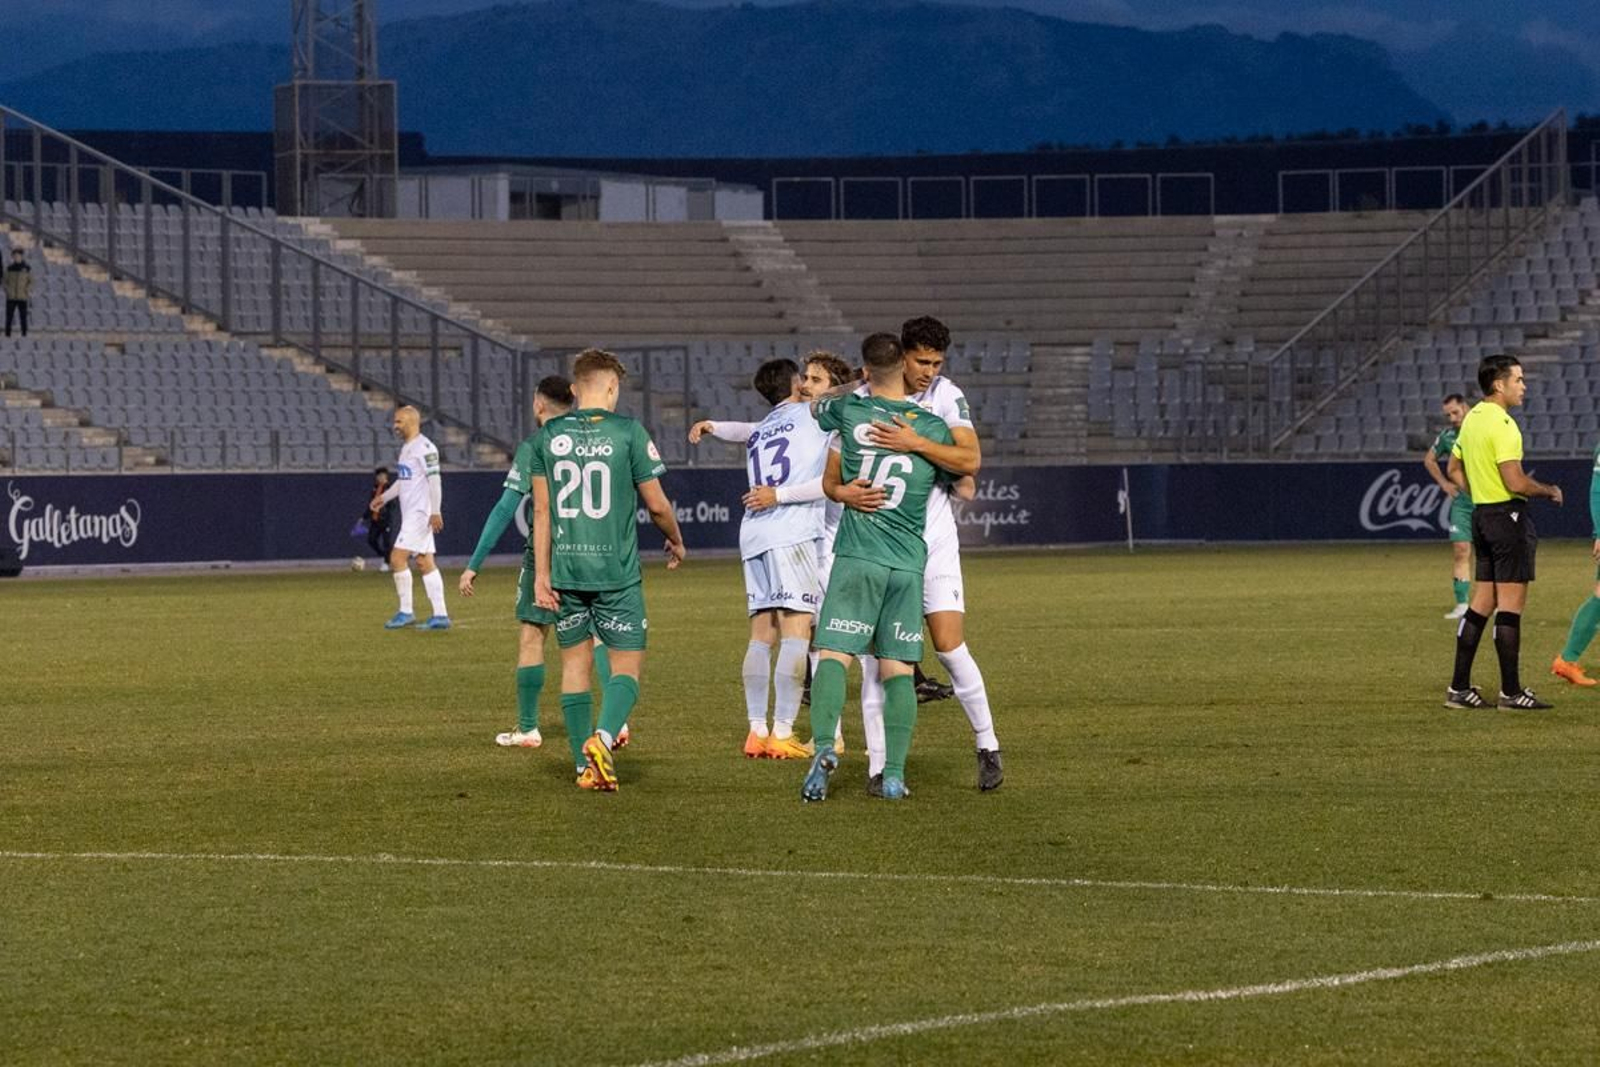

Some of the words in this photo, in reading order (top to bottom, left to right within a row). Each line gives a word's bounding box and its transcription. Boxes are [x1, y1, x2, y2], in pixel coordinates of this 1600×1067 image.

[575, 445, 614, 457] OLMO
[761, 423, 795, 441] OLMO
[749, 436, 791, 487] 13
[856, 448, 913, 510] 16
[553, 459, 612, 520] 20
[696, 501, 729, 522] Orta
[7, 480, 141, 560] Galletanas
